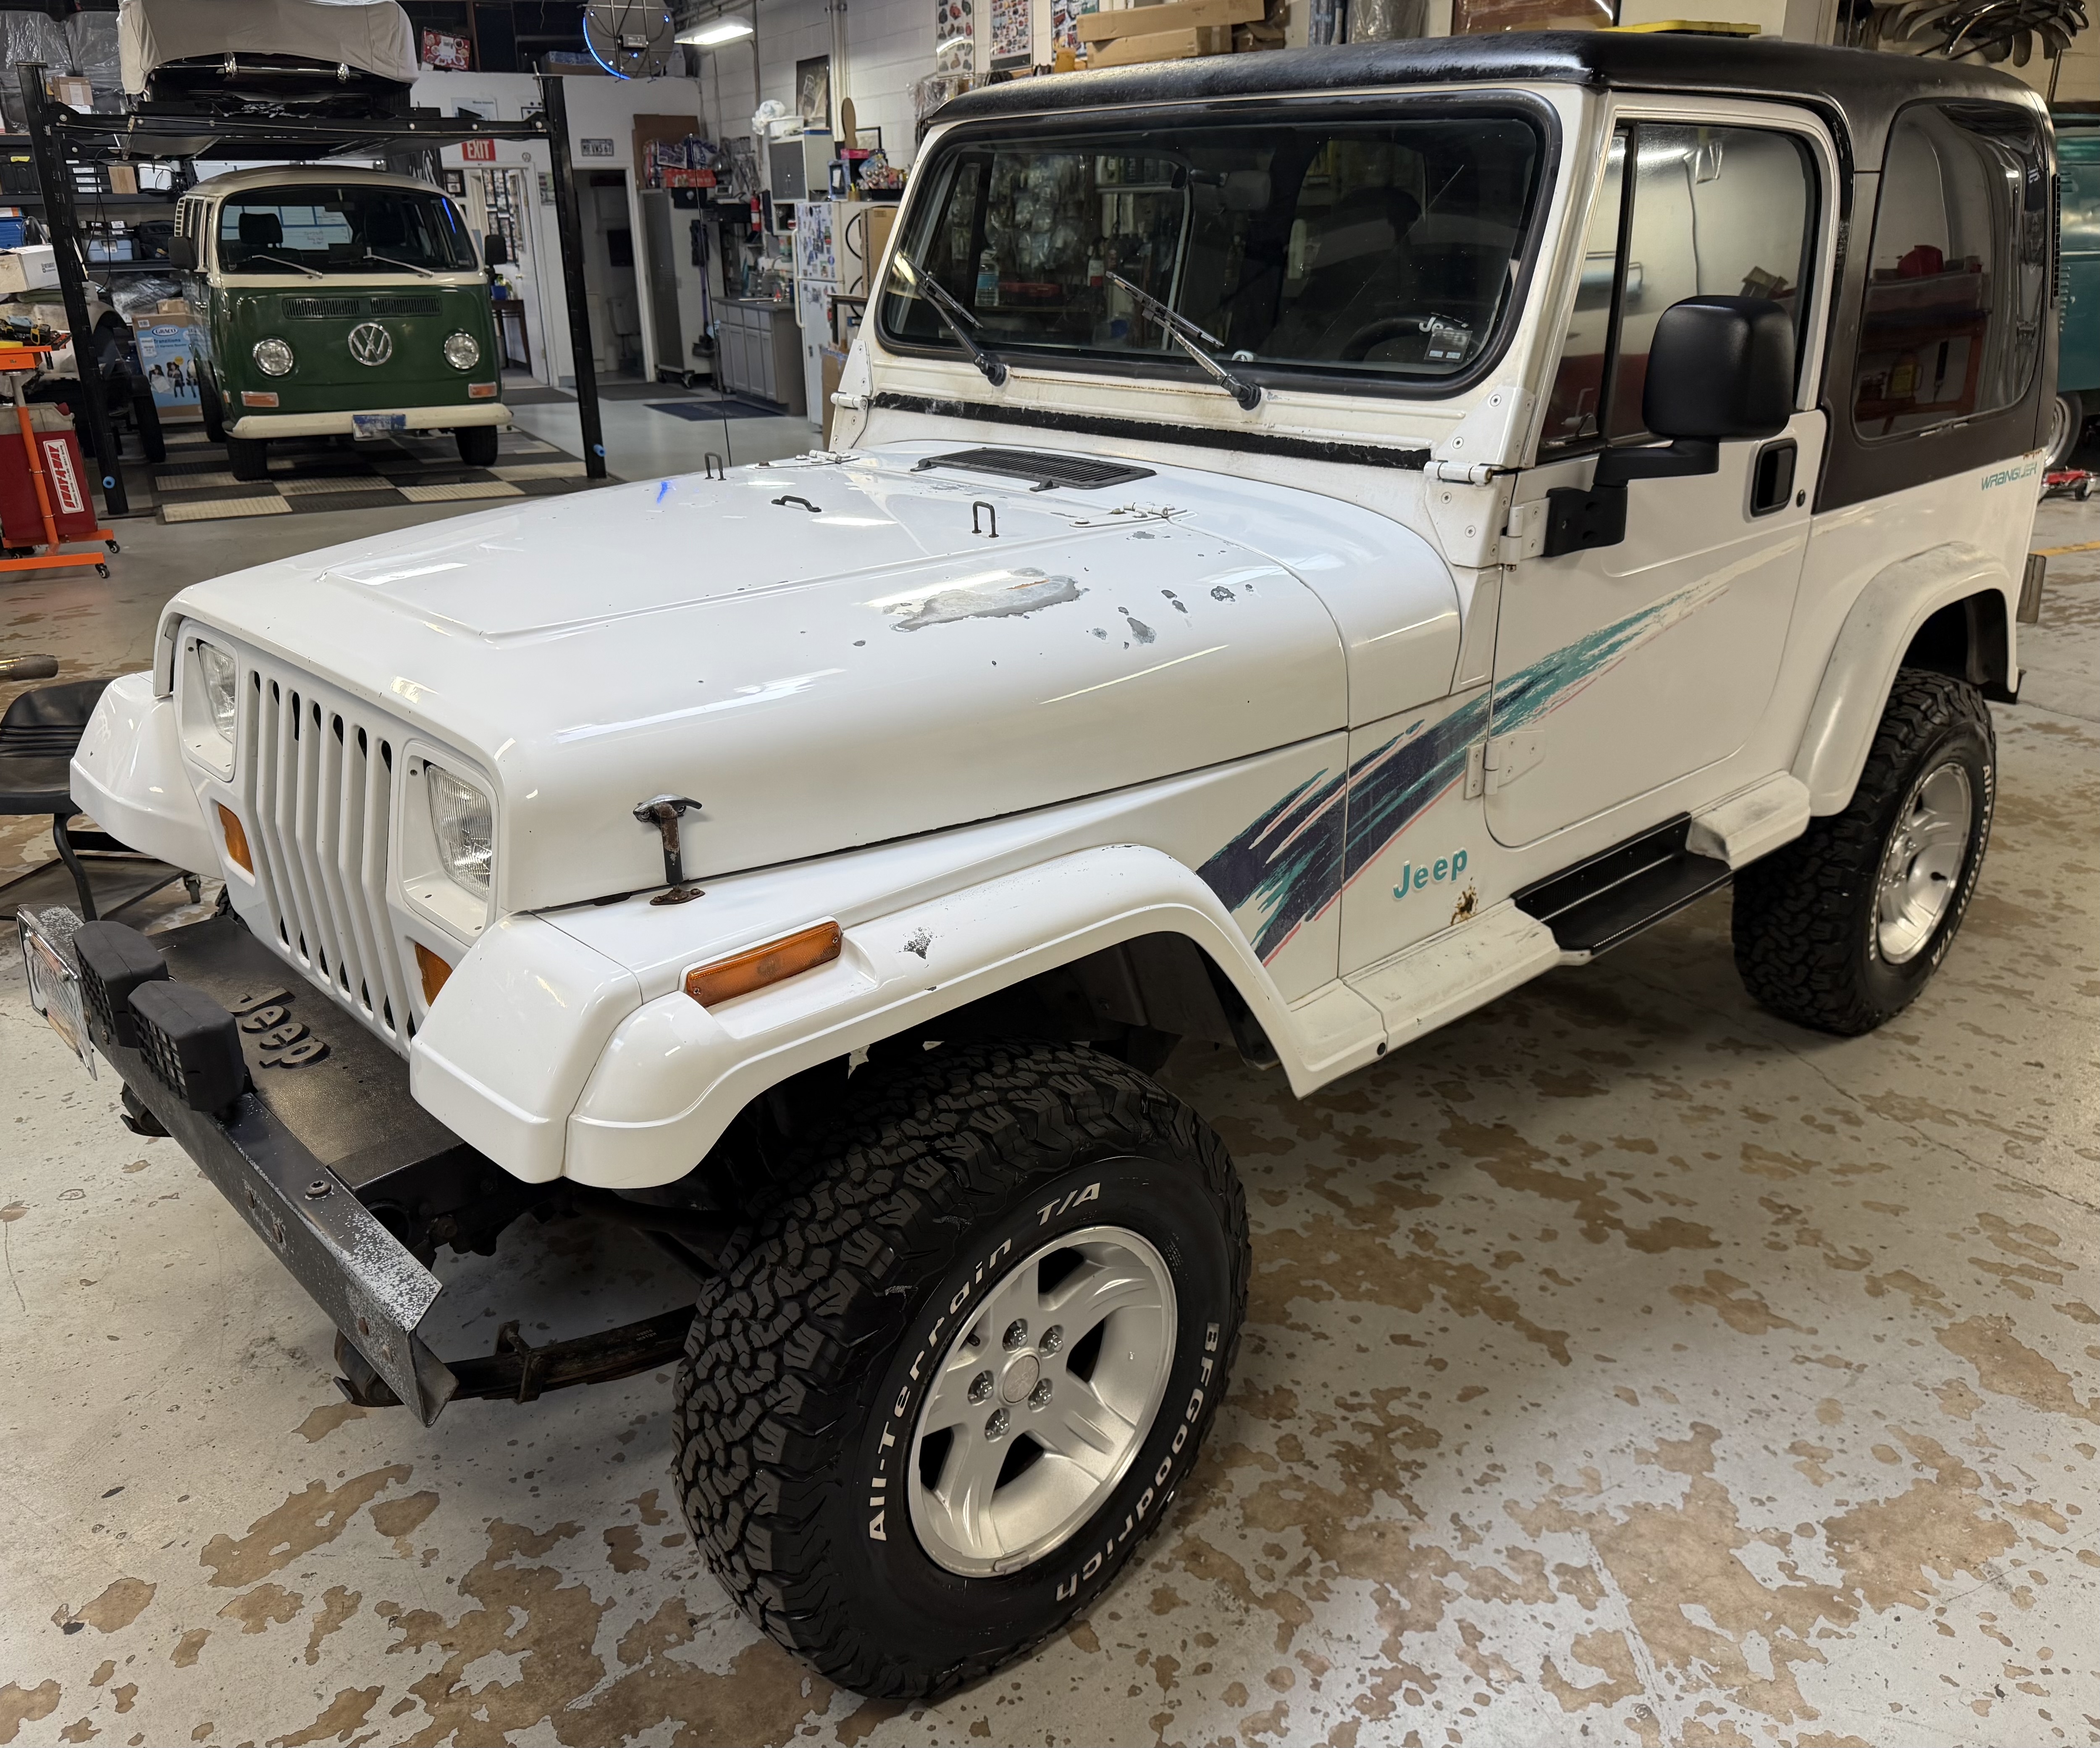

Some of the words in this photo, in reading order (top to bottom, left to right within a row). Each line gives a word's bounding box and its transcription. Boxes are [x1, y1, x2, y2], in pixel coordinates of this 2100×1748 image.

[467, 140, 489, 159] EXIT
[351, 325, 388, 364] VW
[1393, 847, 1467, 899] Jeep
[223, 987, 331, 1068] Jeep
[869, 1237, 1011, 1541] All-Terrain
[1037, 1182, 1100, 1226] T/A
[1056, 1322, 1220, 1602] BFGoodrich
